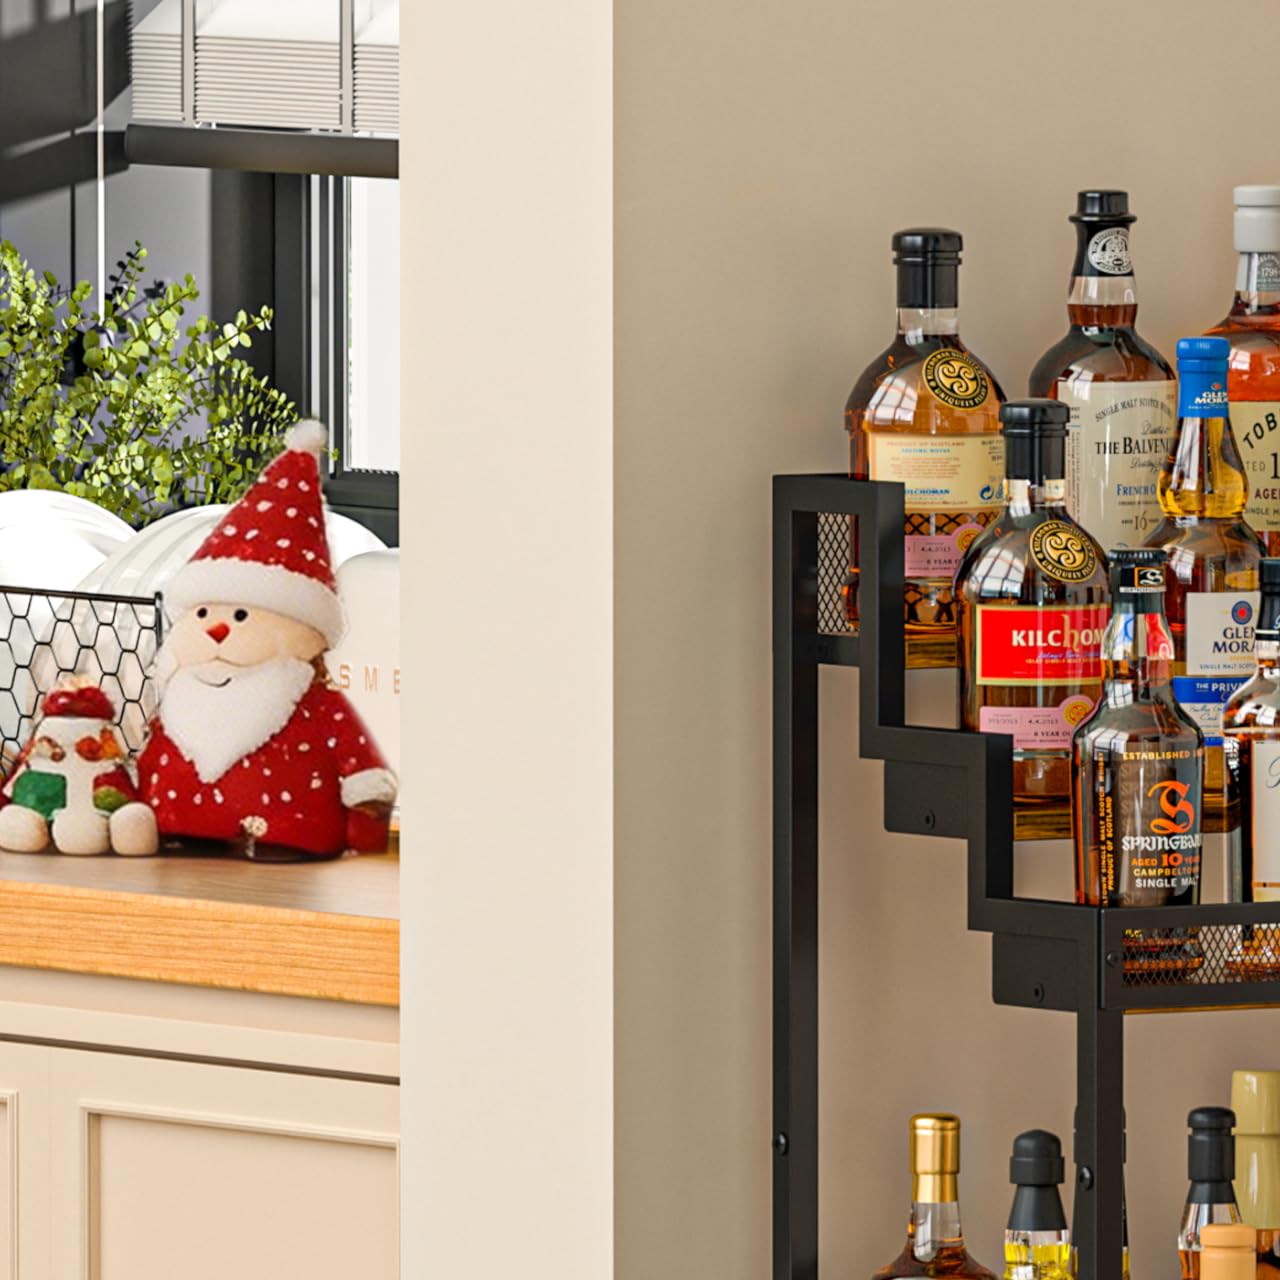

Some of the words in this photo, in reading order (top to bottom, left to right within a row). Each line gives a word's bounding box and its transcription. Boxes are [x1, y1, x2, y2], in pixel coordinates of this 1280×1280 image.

[1120, 398, 1138, 410] MALT
[1095, 441, 1120, 455] THE
[1116, 483, 1149, 497] FRENCH
[1134, 510, 1148, 531] 16
[1199, 663, 1221, 672] SINGLE
[1195, 683, 1210, 692] THE
[1122, 749, 1190, 761] ESTABLISHED
[1105, 796, 1114, 838] SCOTLAND
[1099, 820, 1107, 842] MALT
[1106, 840, 1114, 852] OF
[1131, 857, 1158, 867] AGED
[1161, 852, 1184, 867] 10
[1107, 853, 1116, 891] PRODUCT
[1135, 878, 1178, 888] SINGLE
